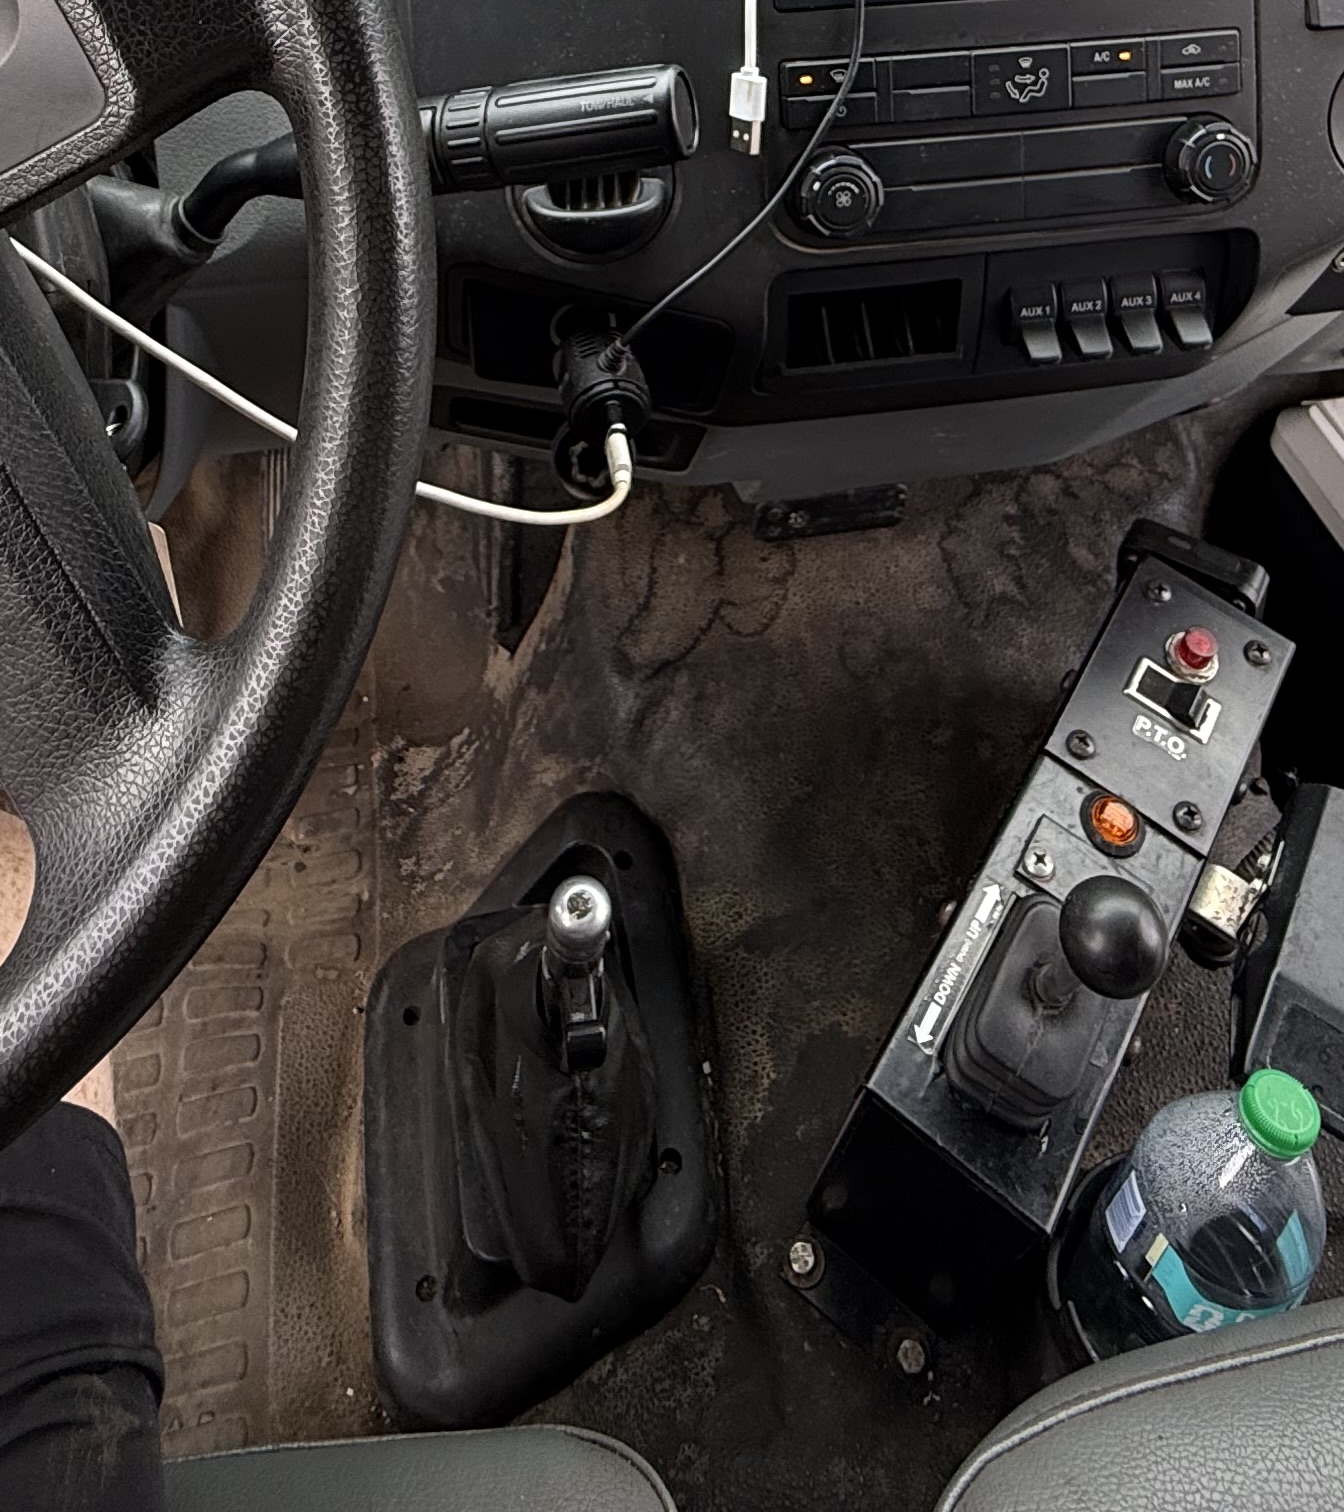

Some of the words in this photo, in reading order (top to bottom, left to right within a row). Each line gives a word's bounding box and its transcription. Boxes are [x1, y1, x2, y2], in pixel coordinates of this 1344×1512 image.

[1094, 51, 1111, 63] A/C
[1174, 78, 1193, 89] MAX
[1195, 76, 1211, 88] A/C
[1121, 297, 1145, 308] AUX
[1168, 292, 1193, 303] AUX
[1020, 307, 1042, 317] AUX
[1071, 301, 1094, 313] AUX
[1135, 715, 1187, 758] P.T.O.
[934, 963, 961, 1005] DOWN
[966, 920, 982, 939] UP
